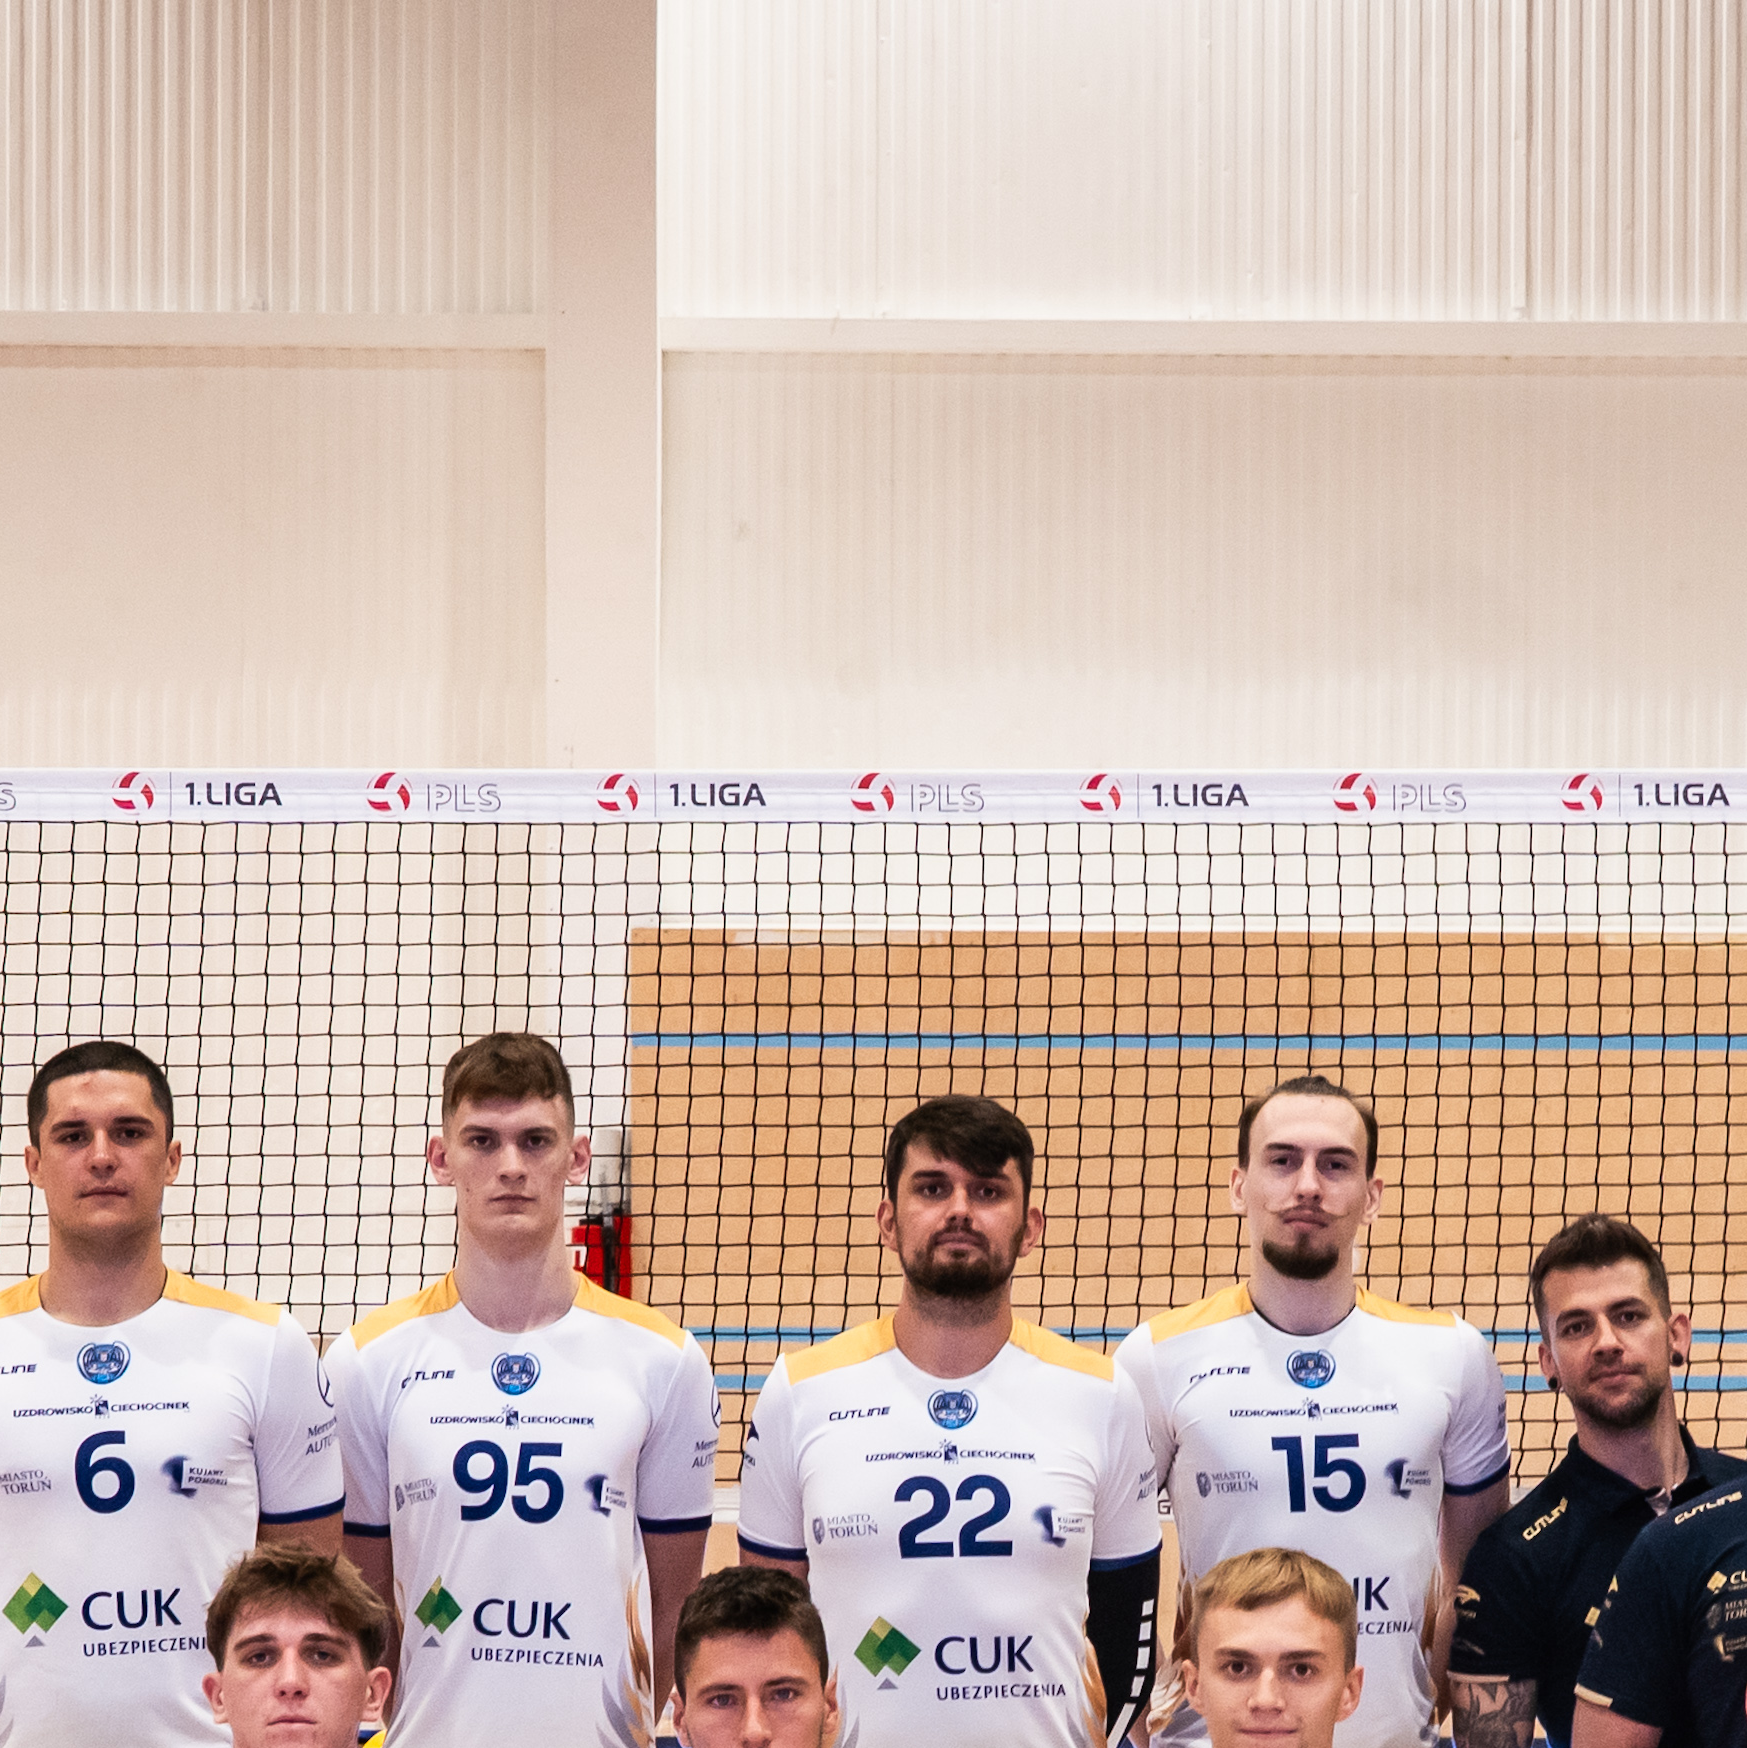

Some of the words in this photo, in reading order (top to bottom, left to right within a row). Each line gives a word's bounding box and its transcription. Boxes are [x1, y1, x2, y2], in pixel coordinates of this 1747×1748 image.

[13, 1405, 94, 1418] UZDROWISKO
[111, 1401, 191, 1413] CIECHOCINEK
[430, 1415, 507, 1426] UZDROWISKO
[520, 1415, 596, 1428] CIECHOCINEK
[828, 1405, 891, 1422] CUTLINE
[865, 1451, 943, 1464] UZDROWISKO
[960, 1448, 1037, 1462] CIECHOCINEK
[74, 1430, 136, 1514] 6
[452, 1440, 564, 1524] 95
[1270, 1434, 1366, 1513] 15
[893, 1475, 1013, 1560] 22
[81, 1587, 182, 1631] CUK
[472, 1598, 572, 1641] CUK
[83, 1636, 208, 1657] UBEZPIECZENI
[471, 1646, 605, 1668] UBEZPIECZENIA
[934, 1635, 1034, 1676] CUK
[935, 1683, 1067, 1702] UBEZPIECZENIA
